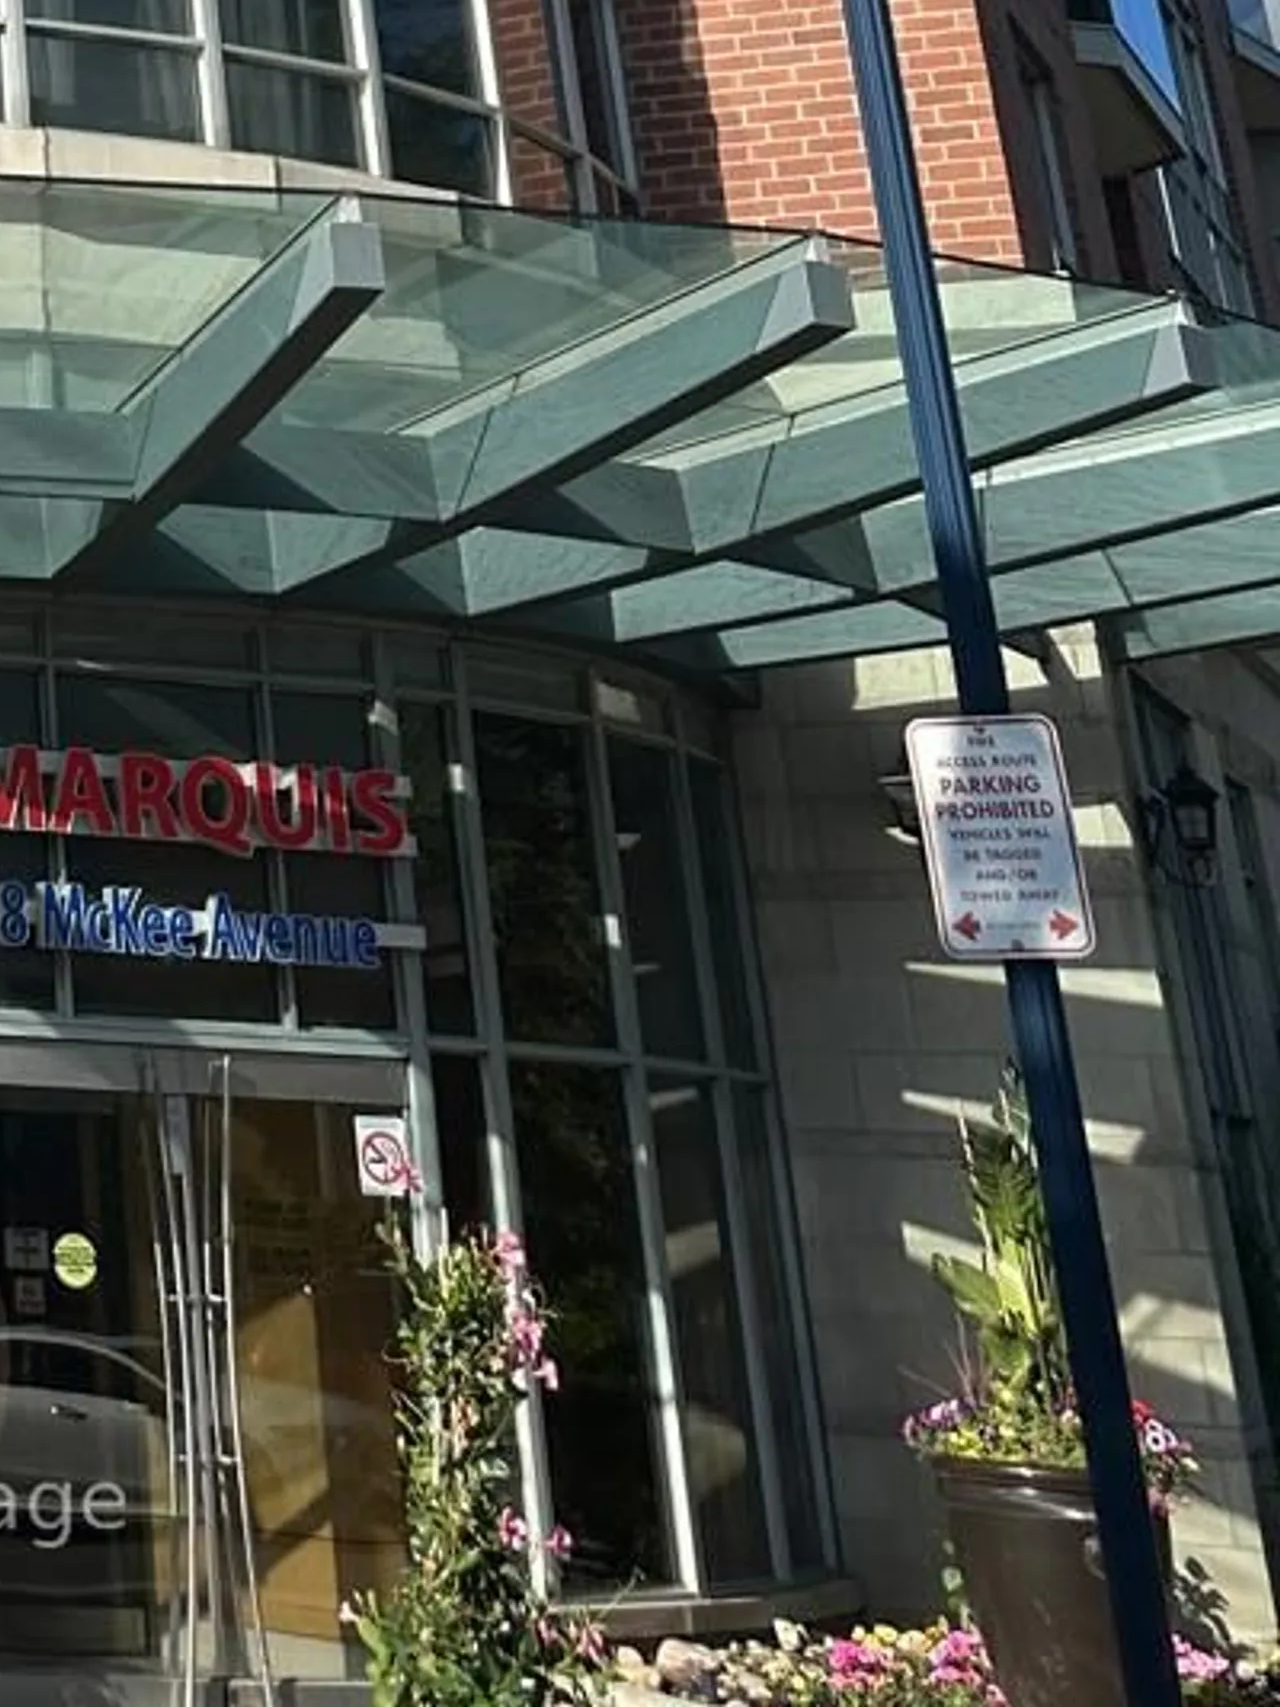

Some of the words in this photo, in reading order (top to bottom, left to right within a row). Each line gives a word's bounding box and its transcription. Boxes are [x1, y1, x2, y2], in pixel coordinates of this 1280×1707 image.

[939, 774, 1042, 795] PARKING
[934, 799, 1055, 822] PROHIBITED
[949, 827, 1012, 841] VEHICLES
[985, 847, 1043, 861] TAGGED
[37, 881, 198, 960] McKee
[203, 890, 382, 969] Avenue
